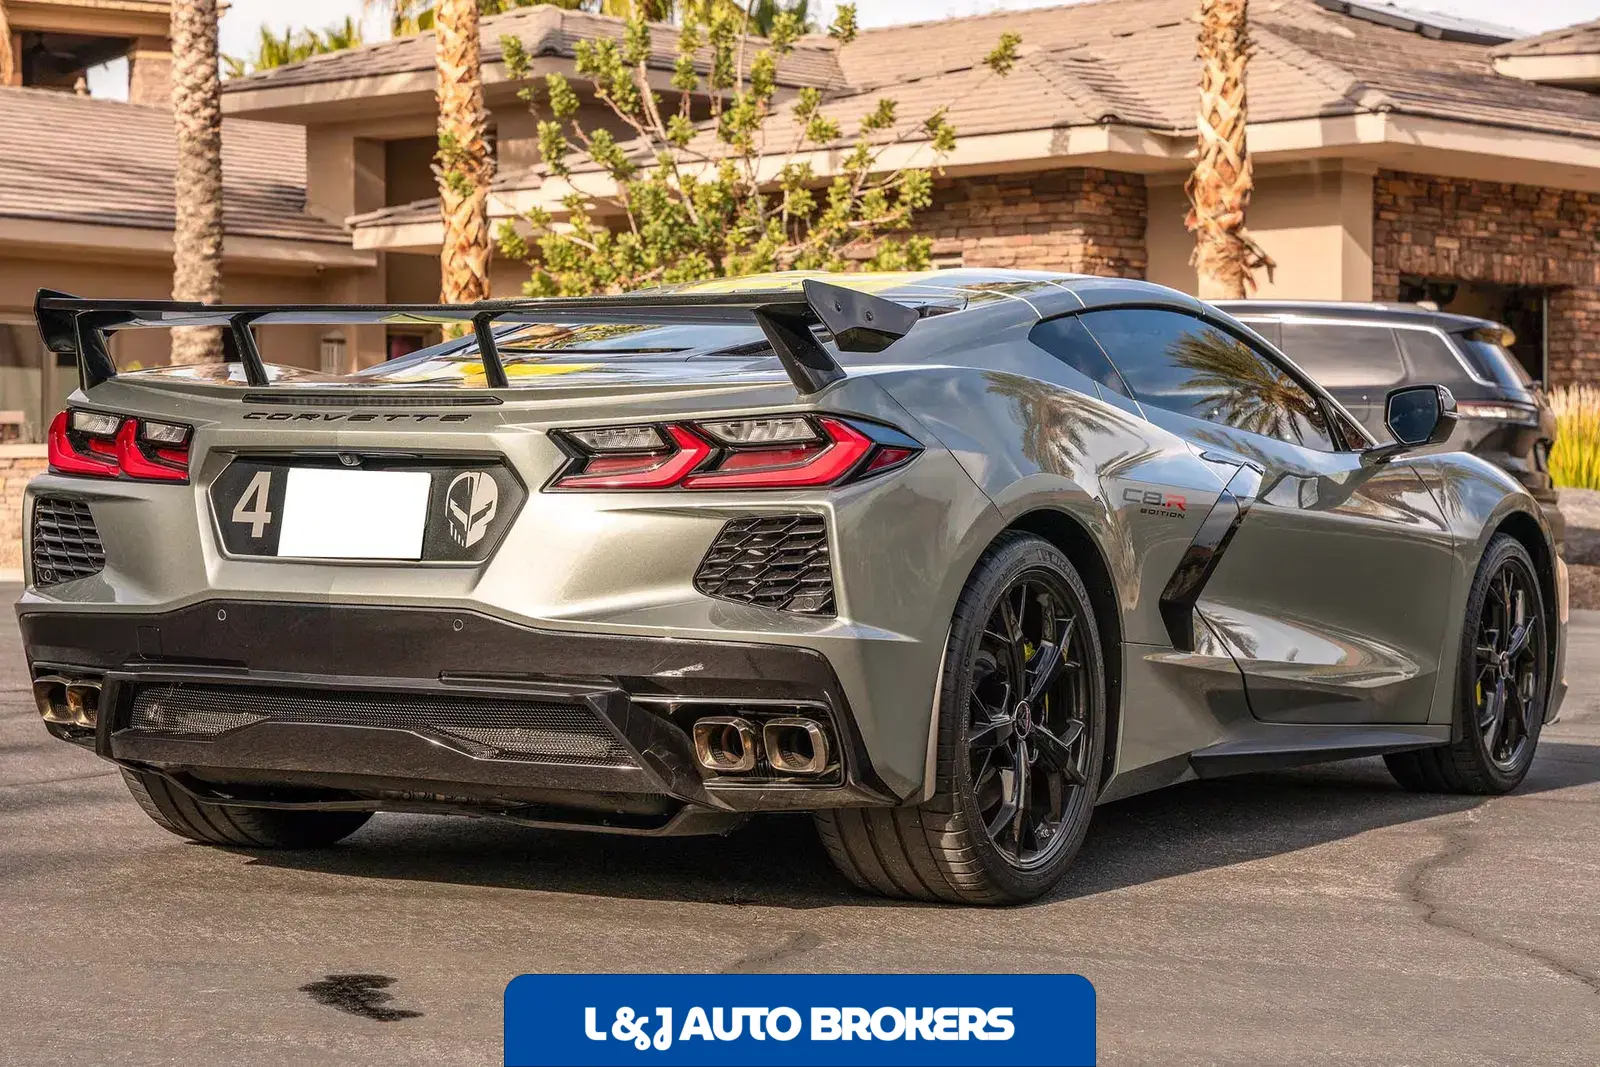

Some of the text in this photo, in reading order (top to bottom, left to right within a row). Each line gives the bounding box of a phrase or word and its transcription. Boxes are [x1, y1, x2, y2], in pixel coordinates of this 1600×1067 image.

[242, 411, 473, 423] CORVETTE
[231, 470, 272, 539] 4
[1122, 487, 1187, 511] C8.R
[1140, 508, 1186, 519] EDITION
